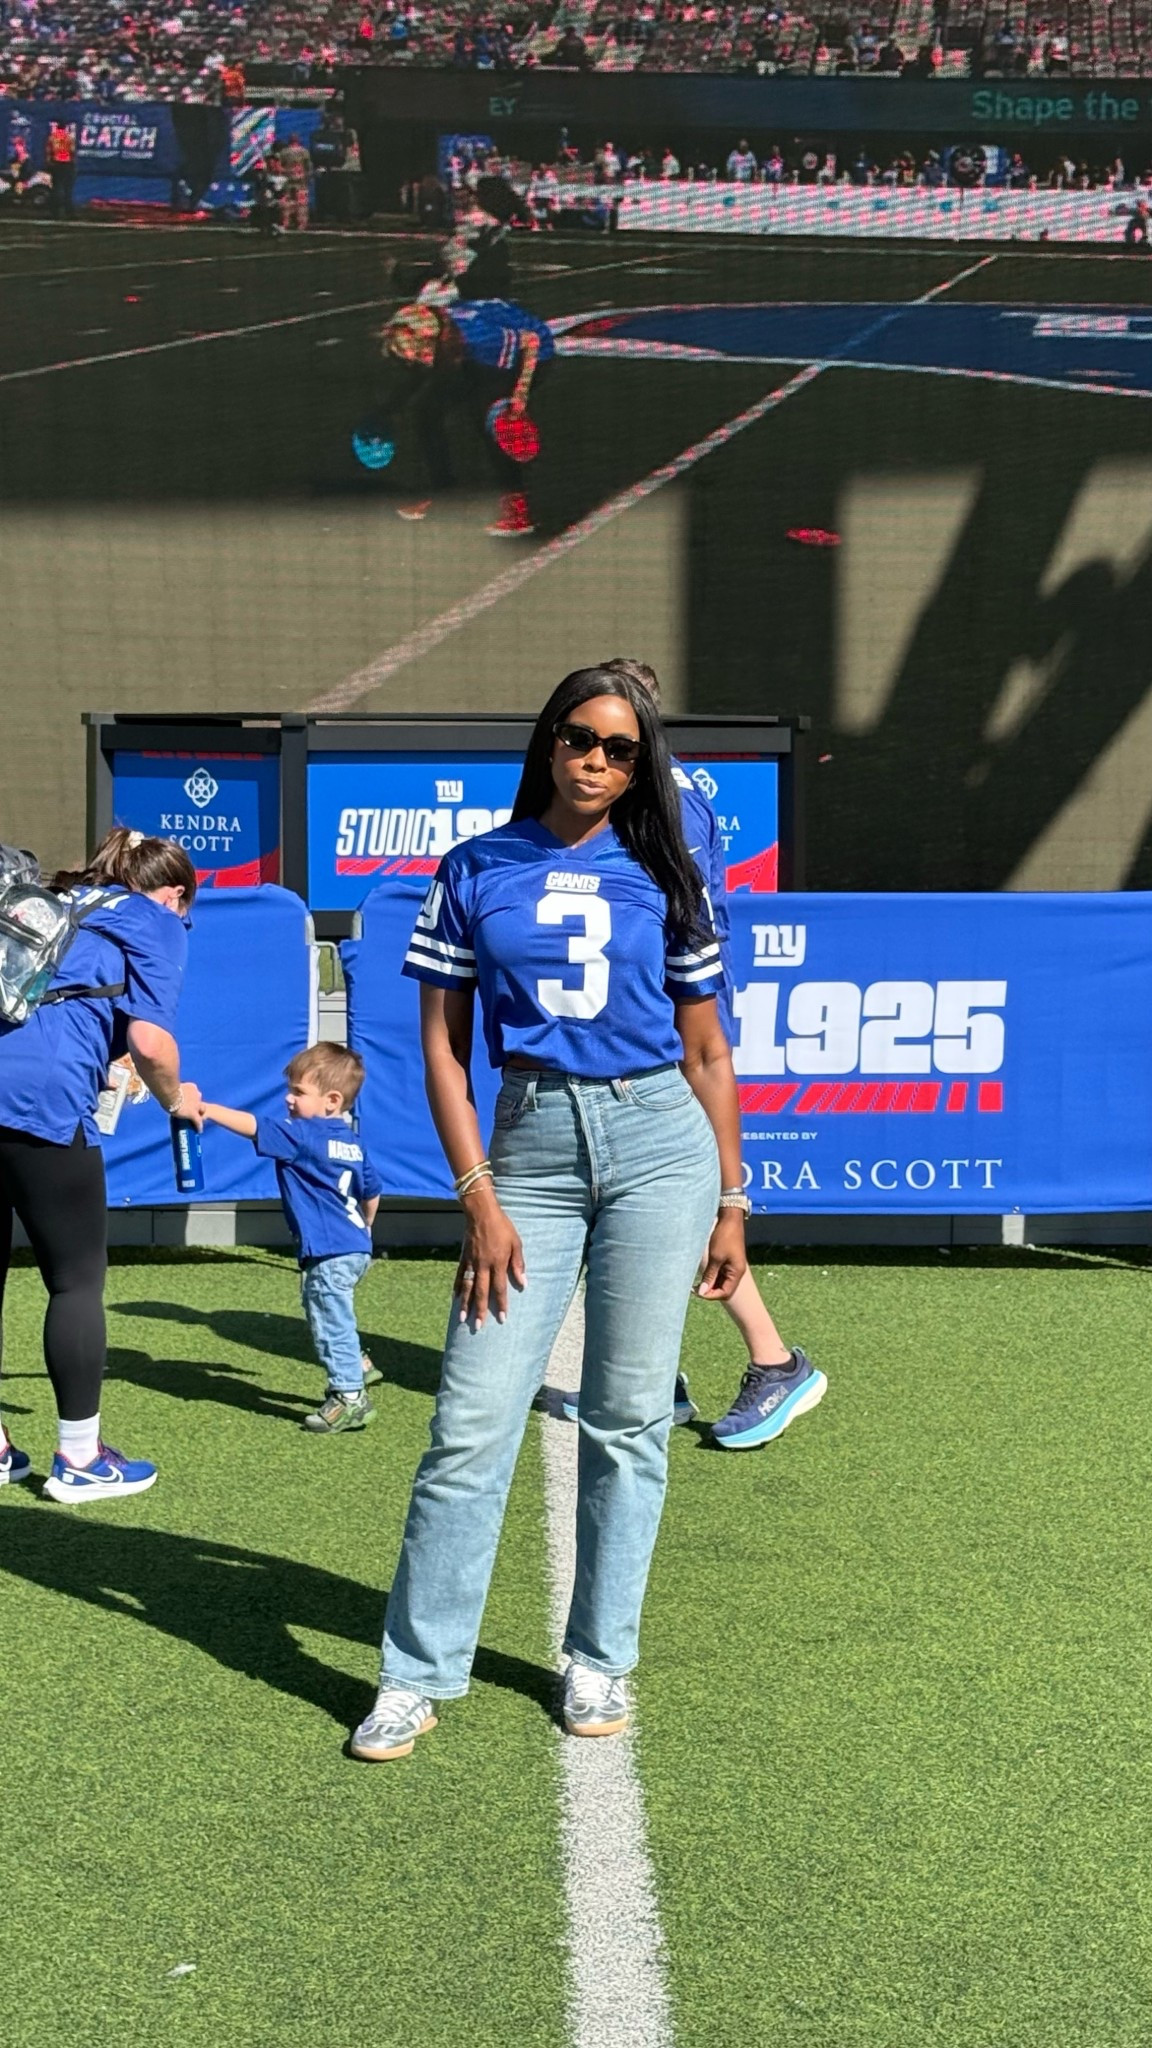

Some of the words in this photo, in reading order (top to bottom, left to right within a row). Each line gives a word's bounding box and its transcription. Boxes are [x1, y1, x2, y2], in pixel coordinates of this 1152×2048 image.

[490, 97, 516, 116] EY
[972, 90, 1073, 126] Shape
[1085, 90, 1139, 121] the
[80, 125, 157, 149] CATCH
[160, 814, 242, 833] KENDRA
[545, 871, 601, 891] GIANTS
[537, 891, 611, 1020] 3
[732, 980, 1007, 1075] 1925
[741, 1132, 799, 1140] ESENTED
[801, 1132, 818, 1140] BY
[740, 1160, 822, 1190] DRA
[843, 1159, 1003, 1190] SCOTT
[757, 1385, 788, 1417] HOKA
